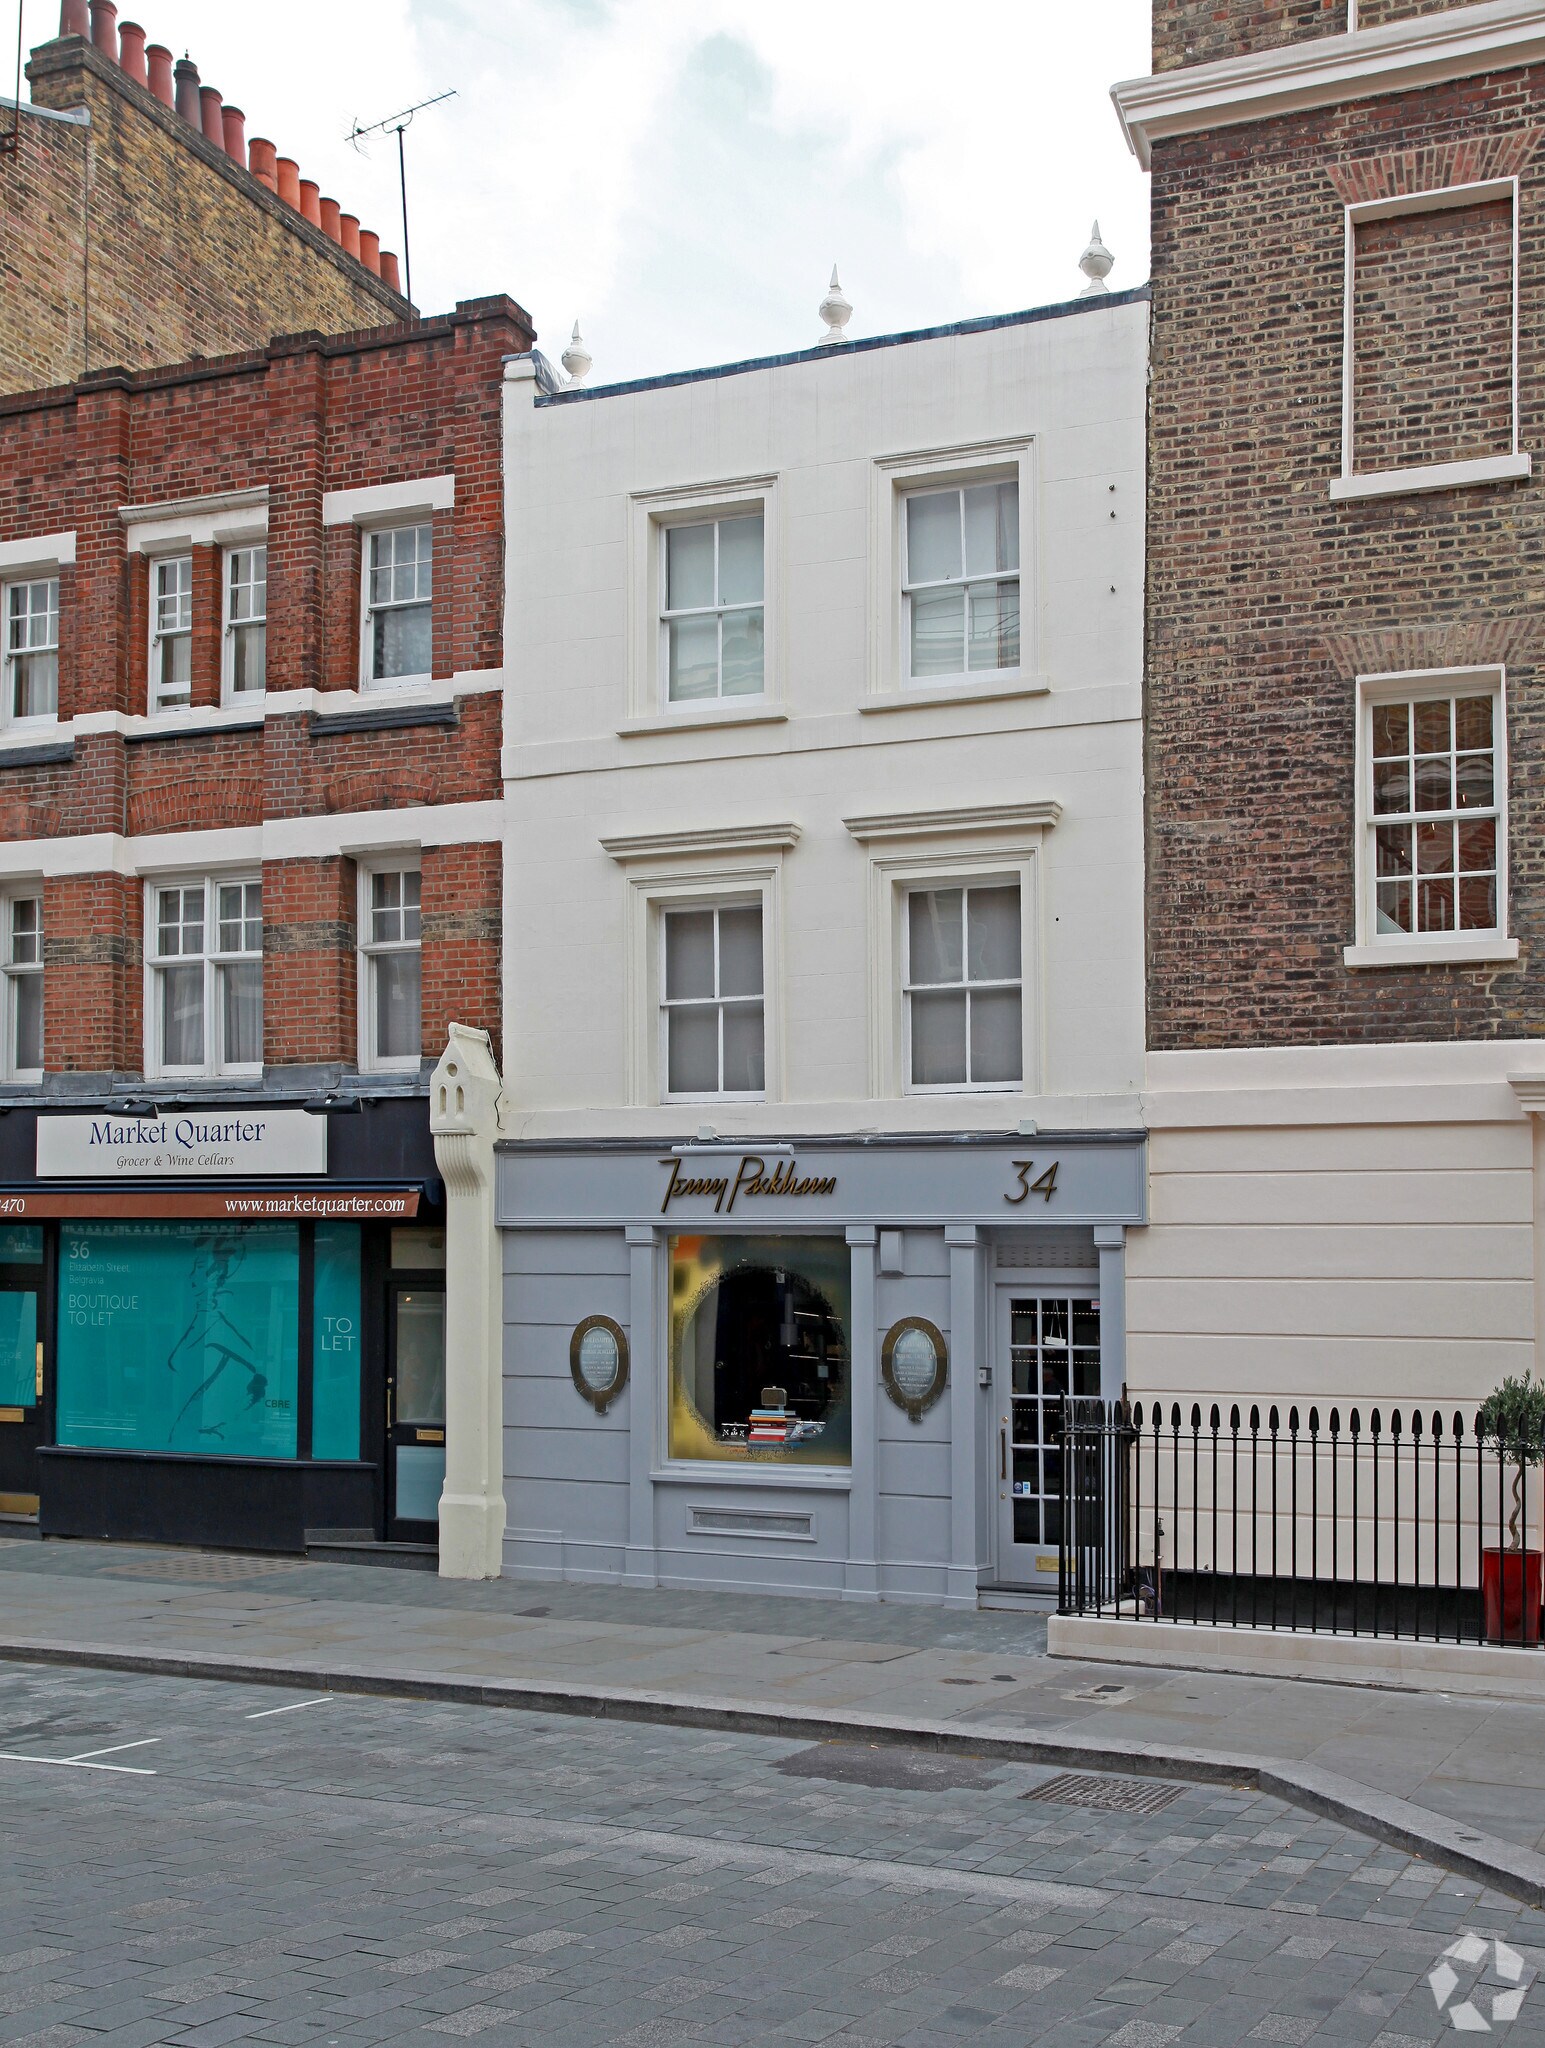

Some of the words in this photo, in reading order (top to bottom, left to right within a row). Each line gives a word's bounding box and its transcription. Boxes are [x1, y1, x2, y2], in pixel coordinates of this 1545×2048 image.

[89, 1120, 168, 1145] Market
[175, 1119, 266, 1149] Quarter
[116, 1155, 151, 1169] Grocer
[153, 1155, 162, 1167] &
[167, 1153, 194, 1167] Wine
[197, 1153, 235, 1167] Cellars
[658, 1157, 728, 1213] Jenny
[726, 1156, 838, 1213] Packham
[1003, 1160, 1060, 1203] 34
[0, 1199, 25, 1213] 470
[225, 1195, 406, 1216] www.marketquarter.com
[69, 1241, 90, 1259] 36
[69, 1262, 105, 1272] Elizabeth
[106, 1263, 130, 1273] Street
[69, 1275, 105, 1286] Belgravia
[68, 1294, 139, 1310] BOUTIQUE
[68, 1310, 87, 1326] TO
[91, 1311, 115, 1326] LET
[323, 1316, 353, 1333] TO
[321, 1335, 357, 1351] LET
[265, 1399, 291, 1409] CBRE
